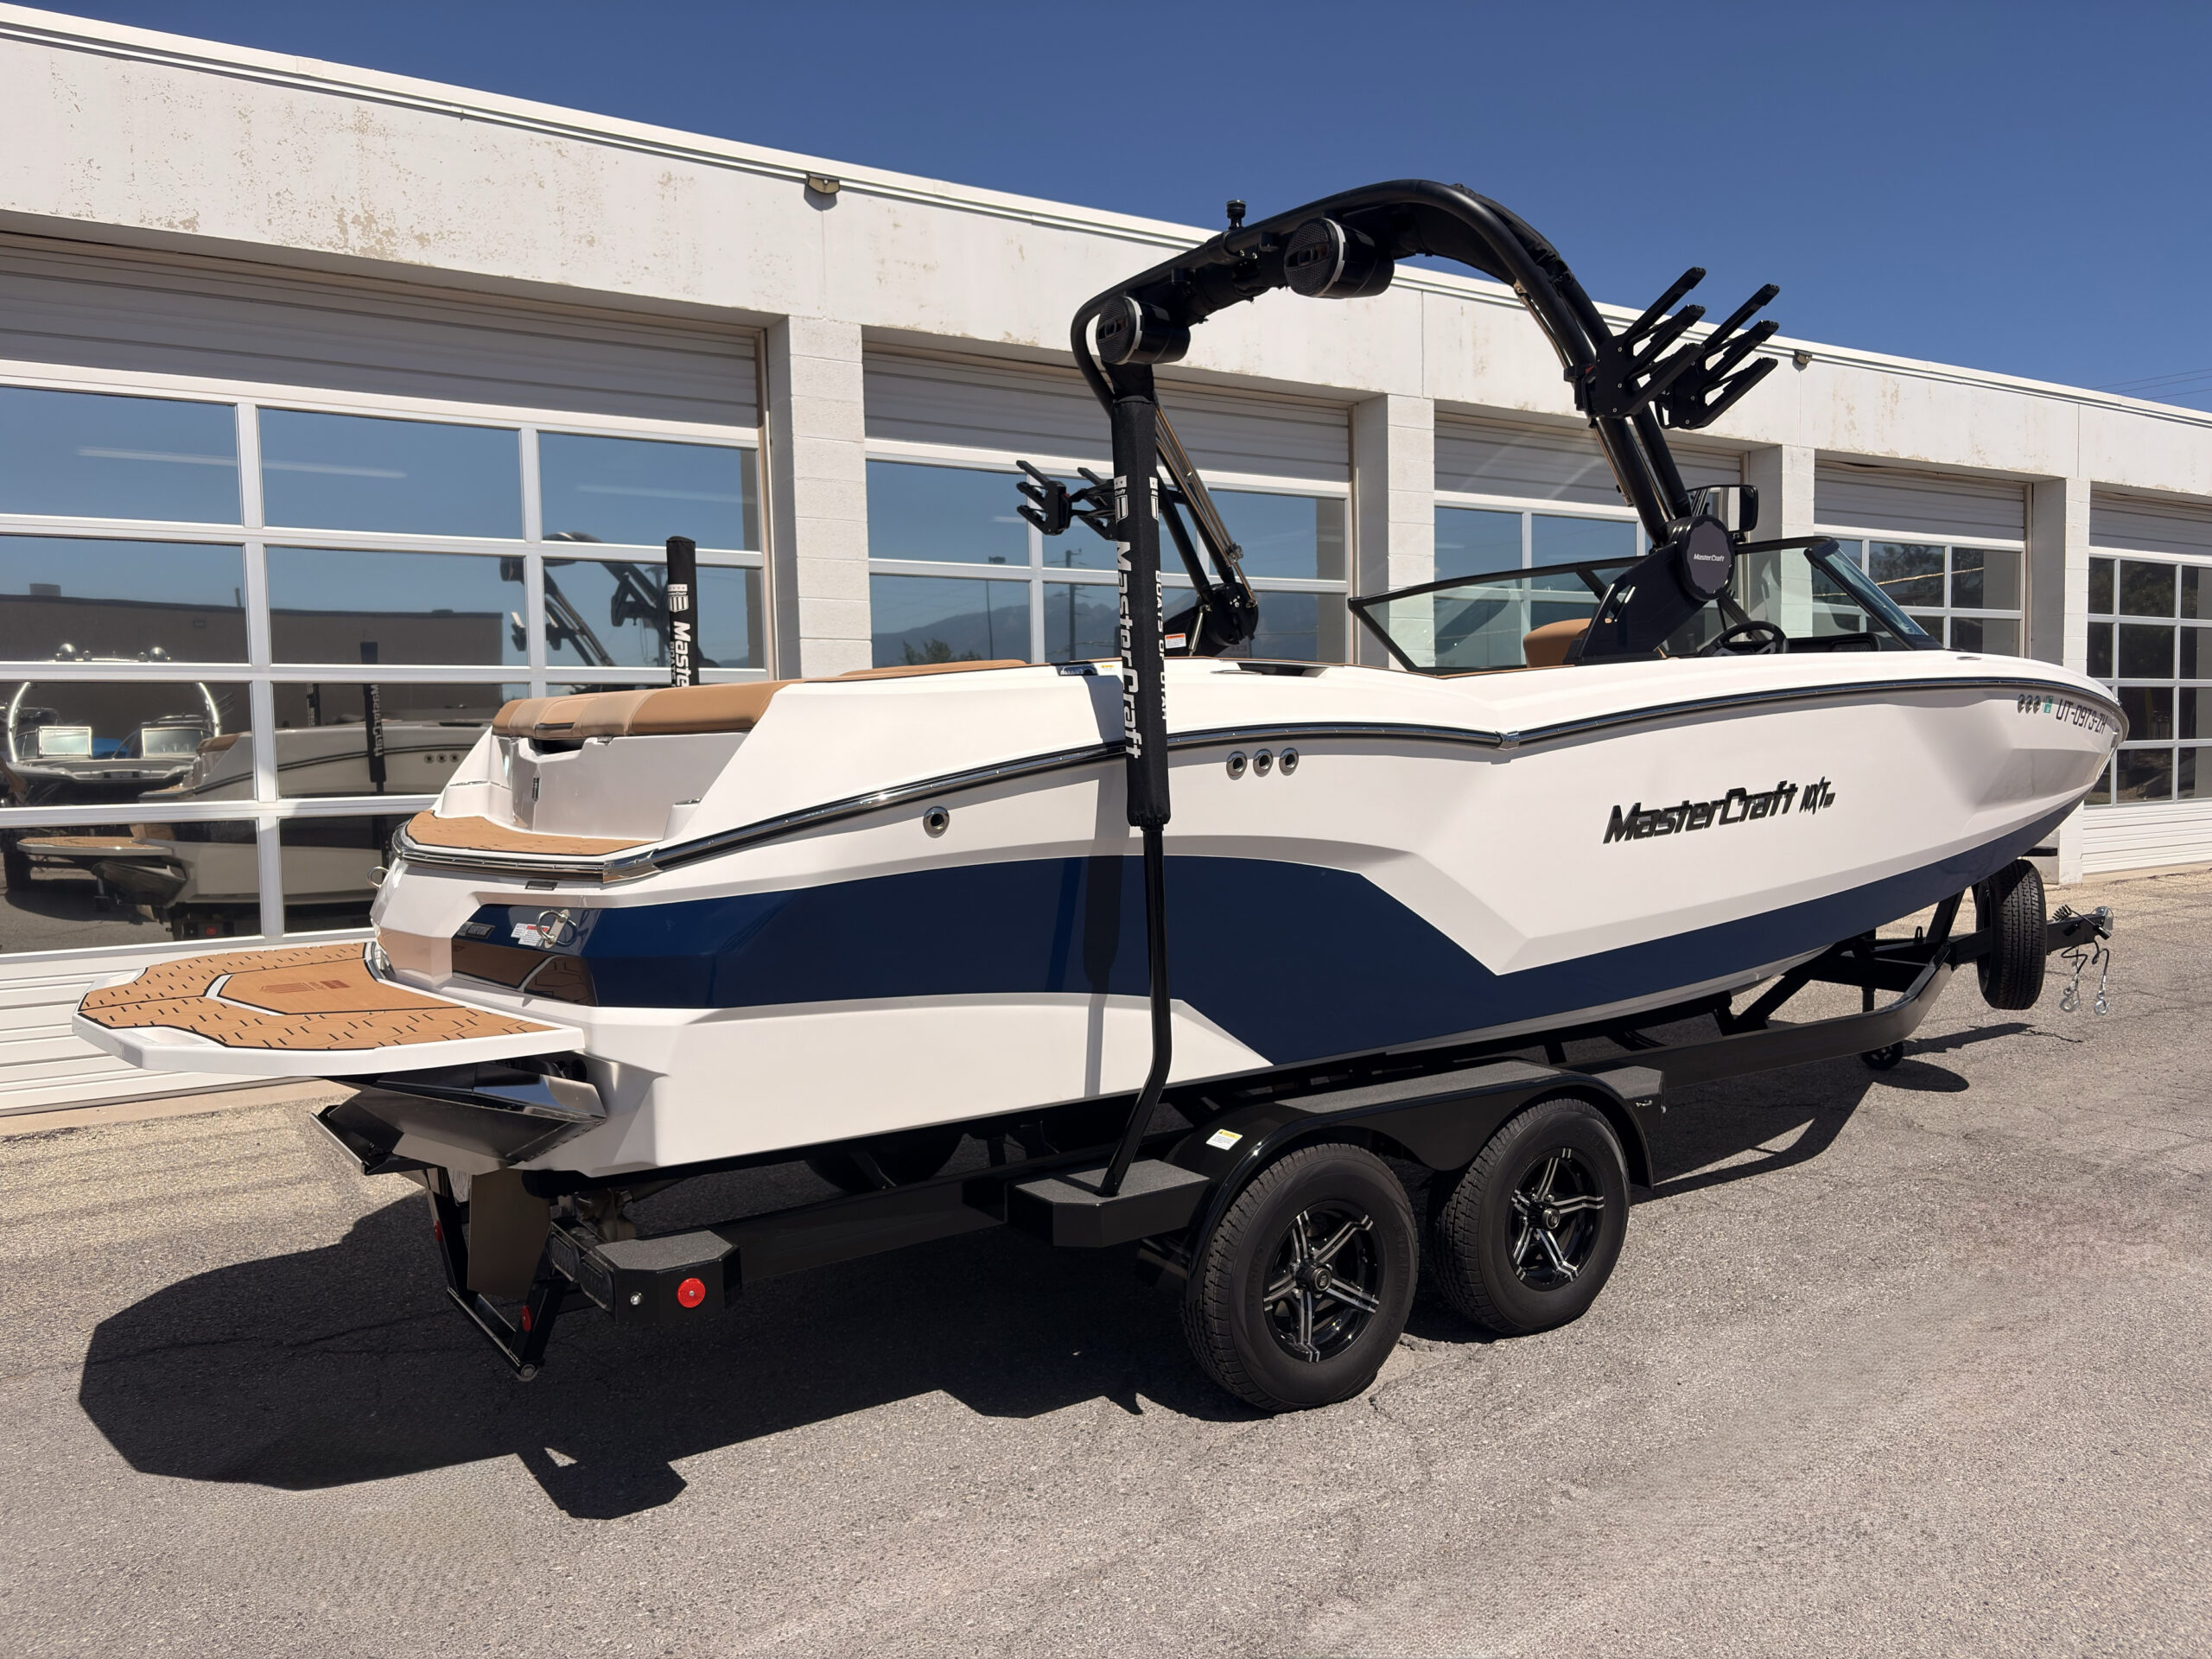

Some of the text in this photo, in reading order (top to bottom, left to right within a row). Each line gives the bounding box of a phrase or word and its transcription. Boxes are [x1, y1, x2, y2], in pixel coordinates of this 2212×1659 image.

[1694, 553, 1725, 562] MasterCraft
[1116, 541, 1142, 759] MasterCraft
[1603, 780, 1798, 843] MasterCraft
